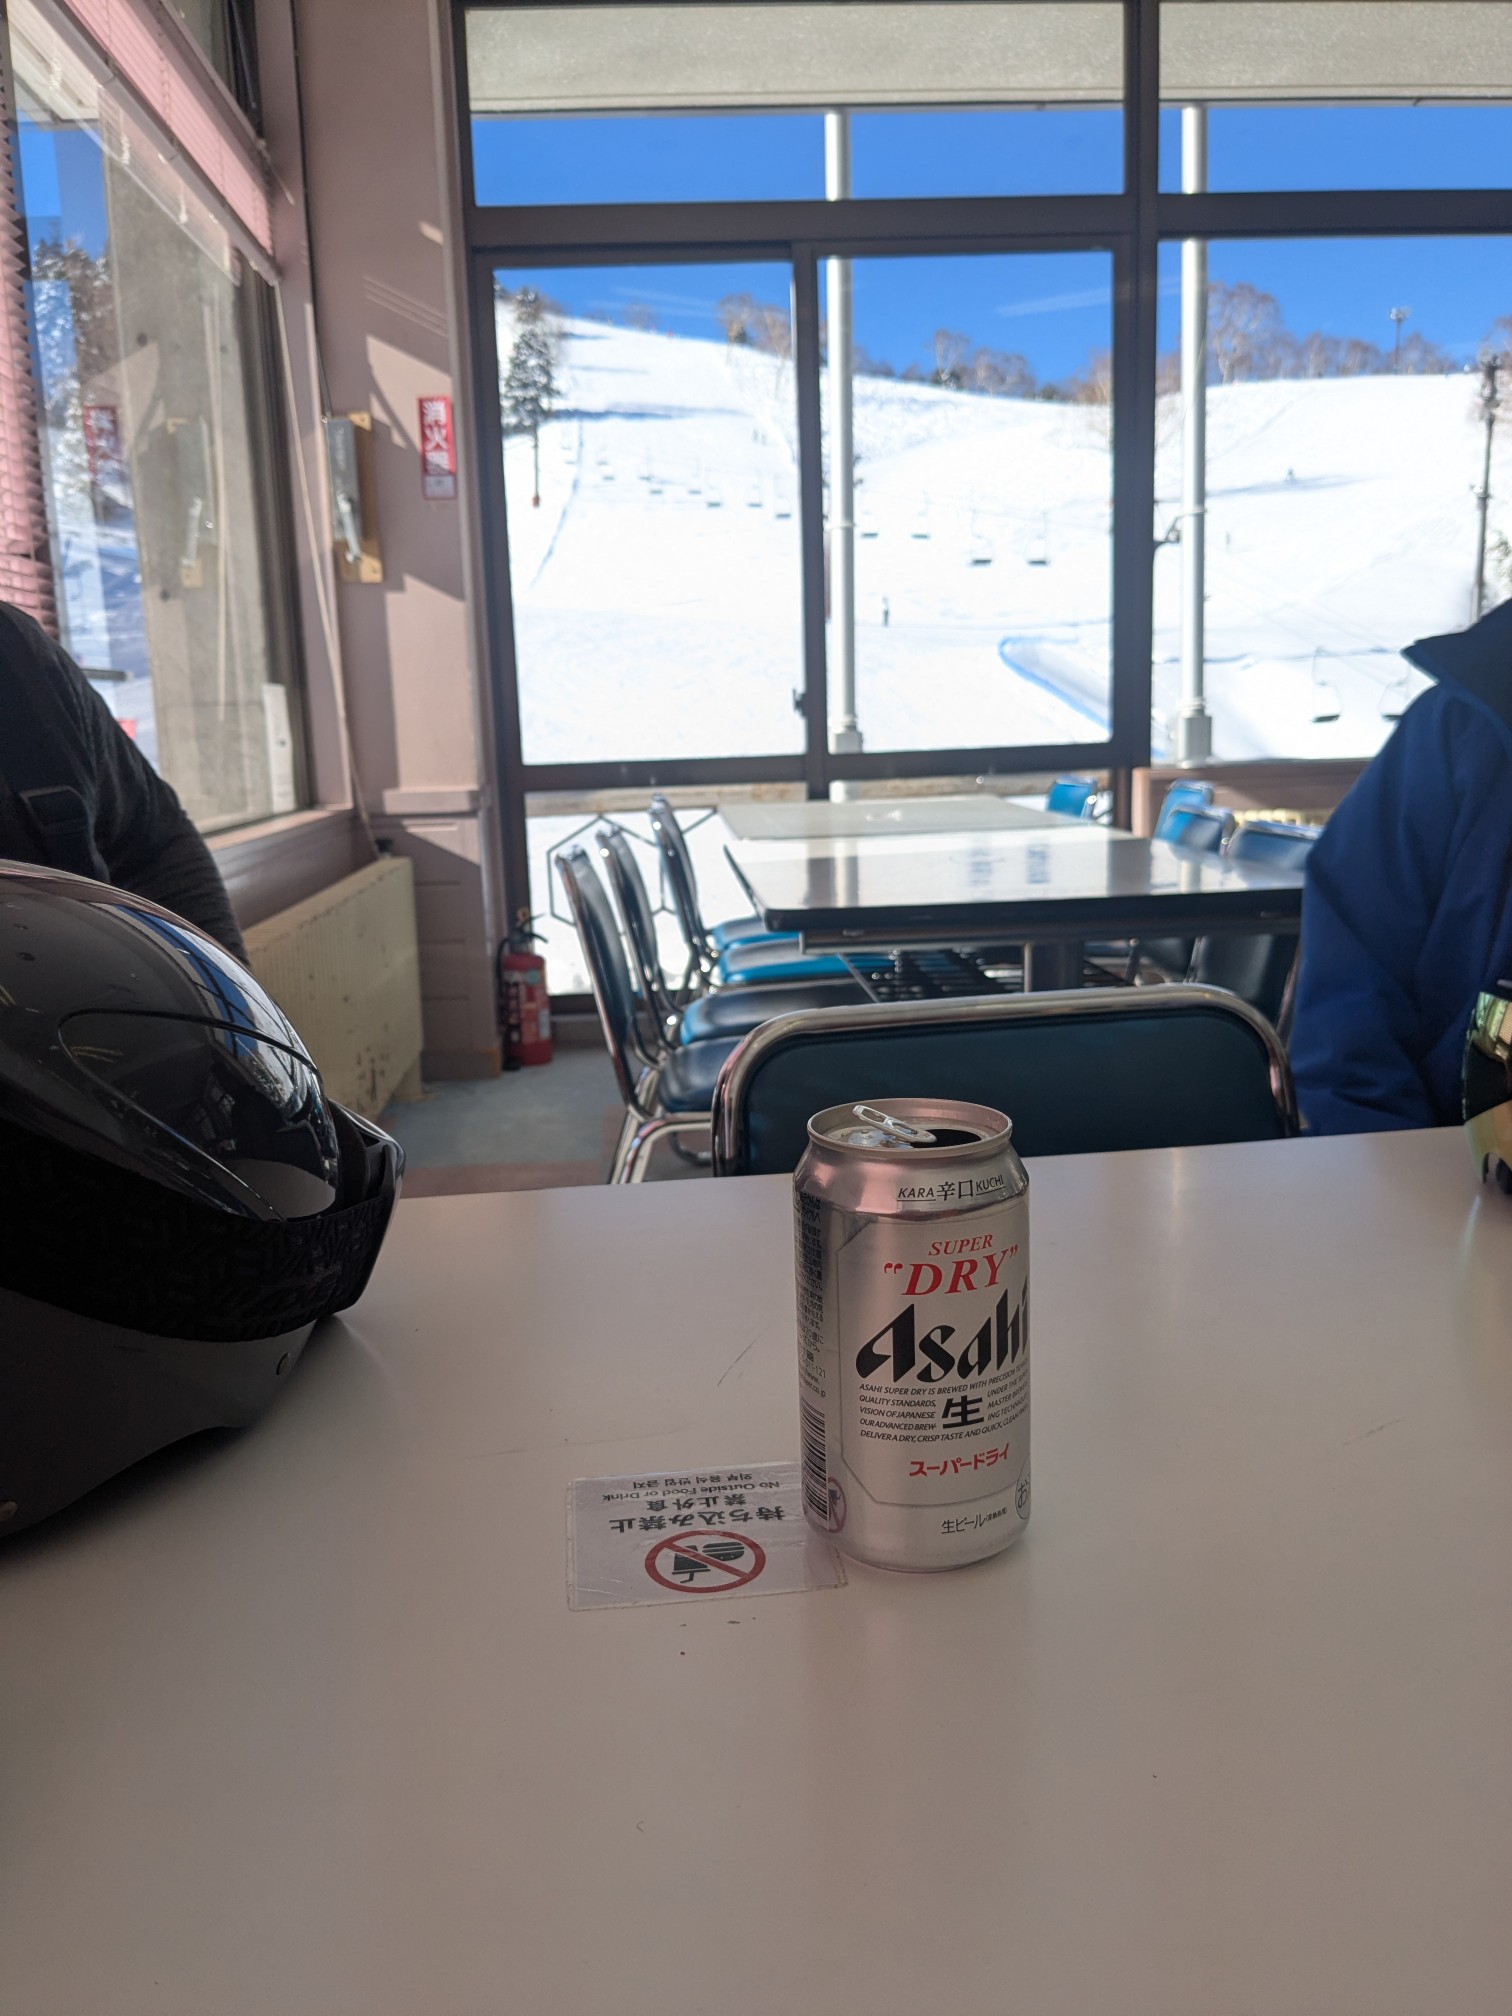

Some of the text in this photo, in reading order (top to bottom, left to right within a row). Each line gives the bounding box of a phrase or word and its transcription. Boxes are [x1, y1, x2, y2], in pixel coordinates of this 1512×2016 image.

[897, 1174, 1004, 1201] KARA 辛口 KUCHI
[928, 1234, 993, 1256] SUPER
[856, 1275, 1028, 1383] Asahi
[859, 1383, 883, 1393] ASAHI
[884, 1386, 909, 1395] SUPER
[928, 1387, 936, 1395] IS
[936, 1384, 968, 1395] BREWED
[969, 1380, 987, 1391] WITH
[859, 1394, 890, 1406] QUALITY
[891, 1399, 937, 1408] STANDARDS,
[987, 1383, 1008, 1397] UNDER
[859, 1405, 885, 1417] VISION
[886, 1410, 897, 1418] OF
[896, 1411, 936, 1419] JAPANESE
[987, 1393, 1011, 1409] MASTER
[941, 1394, 985, 1429] 生
[859, 1418, 875, 1427] OUR
[875, 1421, 914, 1431] ADVANCED
[860, 1429, 892, 1441] DELIVER
[898, 1434, 916, 1443] DRY,
[917, 1434, 940, 1443] CRISP
[940, 1431, 964, 1442] TASTE
[964, 1428, 981, 1438] AND
[909, 1443, 1010, 1477] スーパードライ
[633, 1473, 753, 1489] 외부 음식 반입 금지
[700, 1483, 755, 1493] Outside
[759, 1481, 780, 1489] No
[602, 1491, 640, 1501] Drink
[662, 1487, 697, 1497] Food
[646, 1493, 747, 1512] 禁止外食
[609, 1505, 786, 1533] 持ち込み禁止
